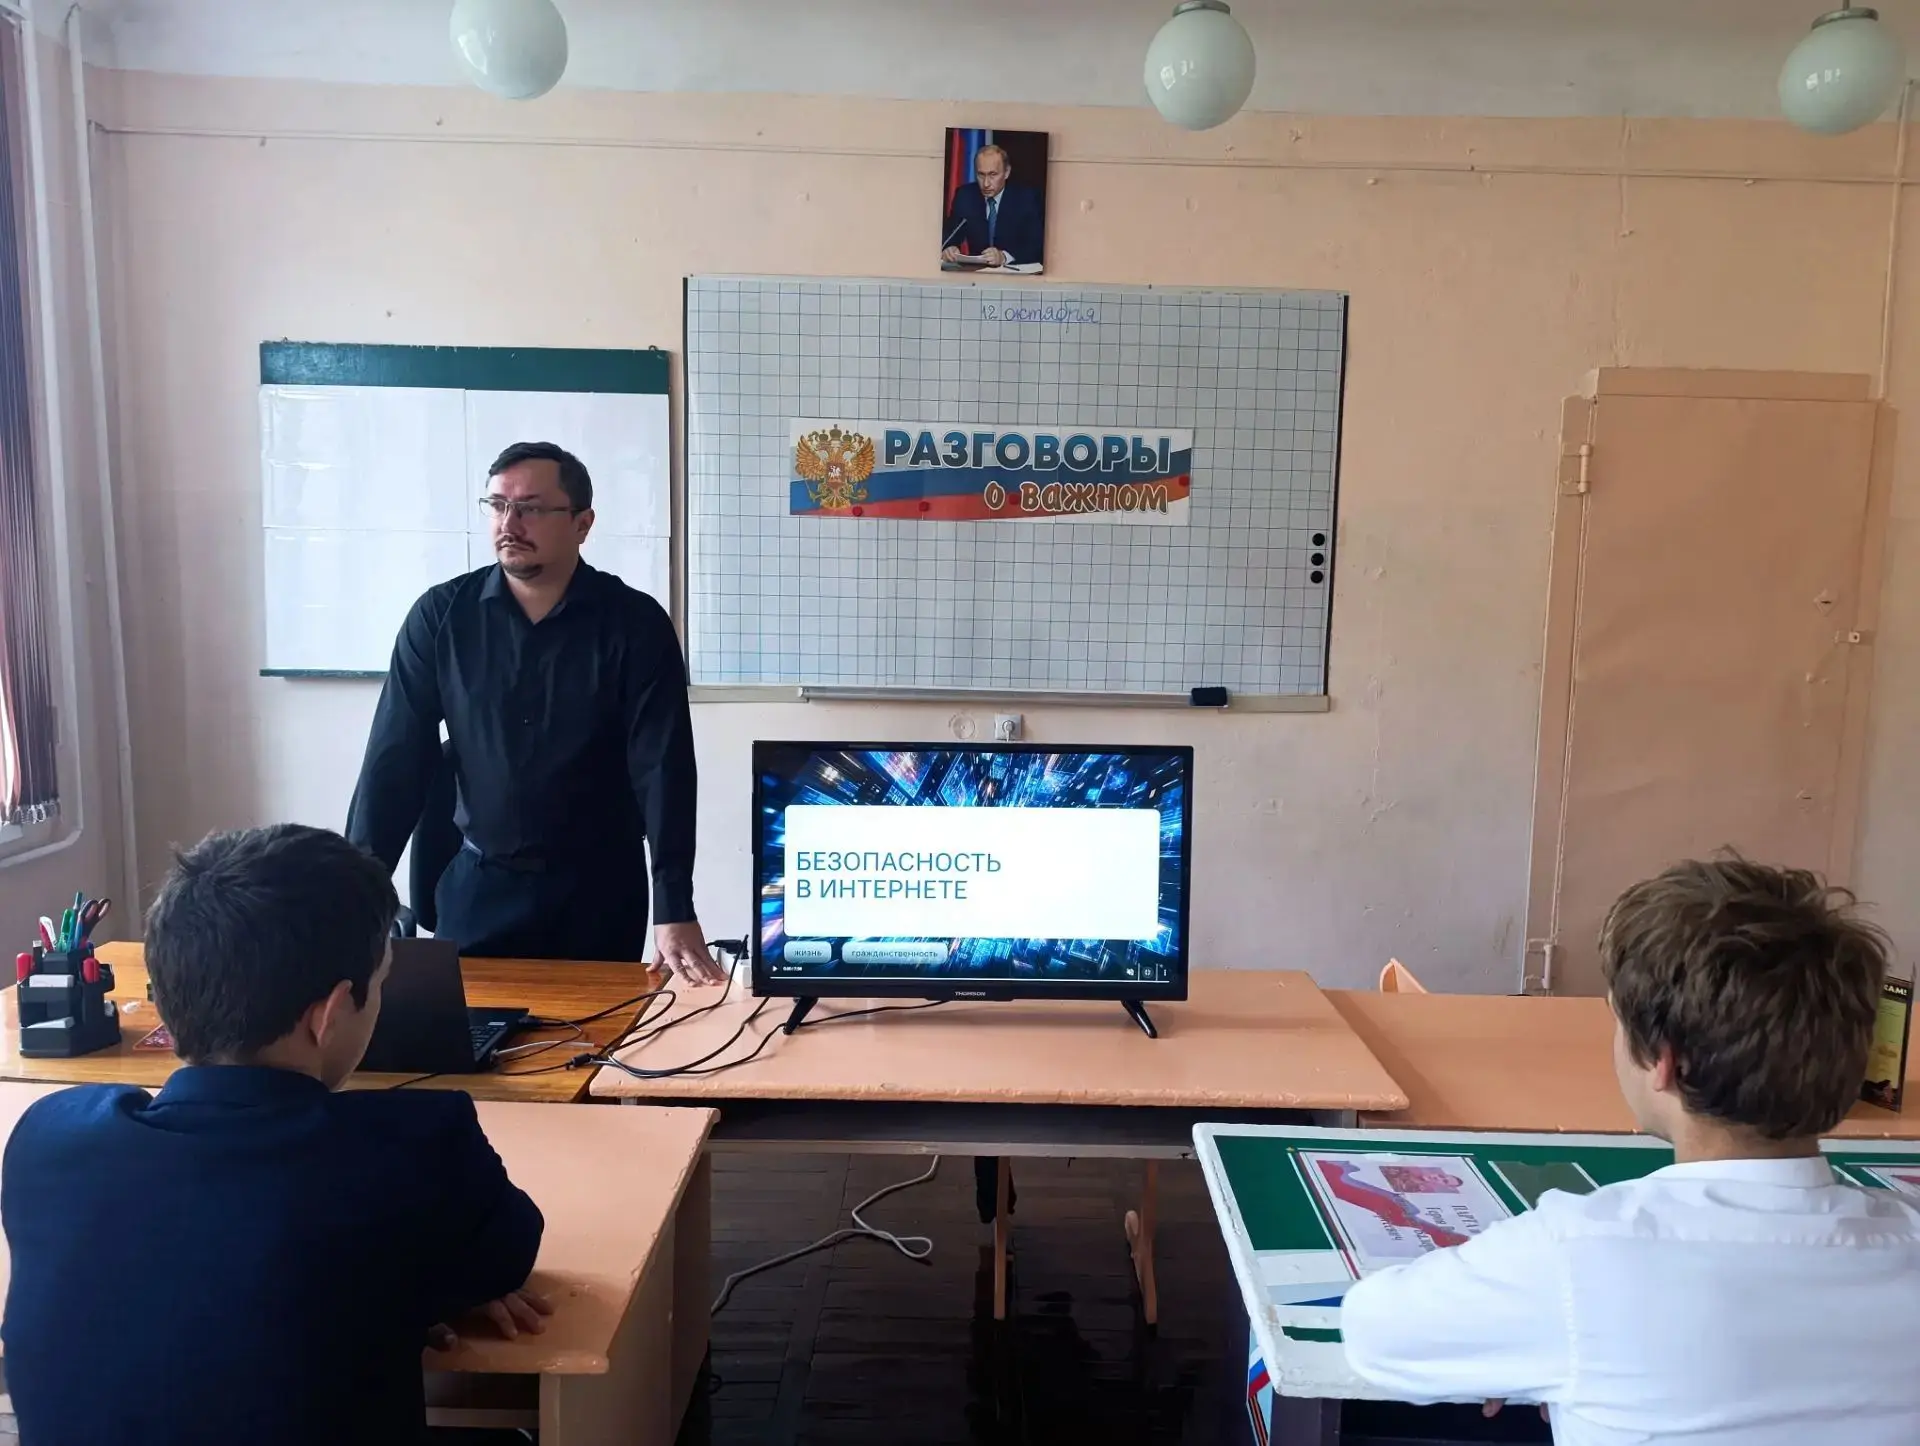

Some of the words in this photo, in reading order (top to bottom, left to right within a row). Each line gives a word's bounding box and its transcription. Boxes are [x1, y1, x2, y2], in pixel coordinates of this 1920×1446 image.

[982, 304, 999, 320] 12
[1004, 298, 1099, 334] октября
[883, 428, 1170, 474] РАЗГОВОРЫ
[796, 852, 1002, 872] БЕЗОПАСНОСТЬ
[796, 879, 811, 899] В
[820, 879, 968, 900] ИНТЕРНЕТЕ
[794, 949, 823, 957] жизнь
[851, 949, 939, 959] гражданственность
